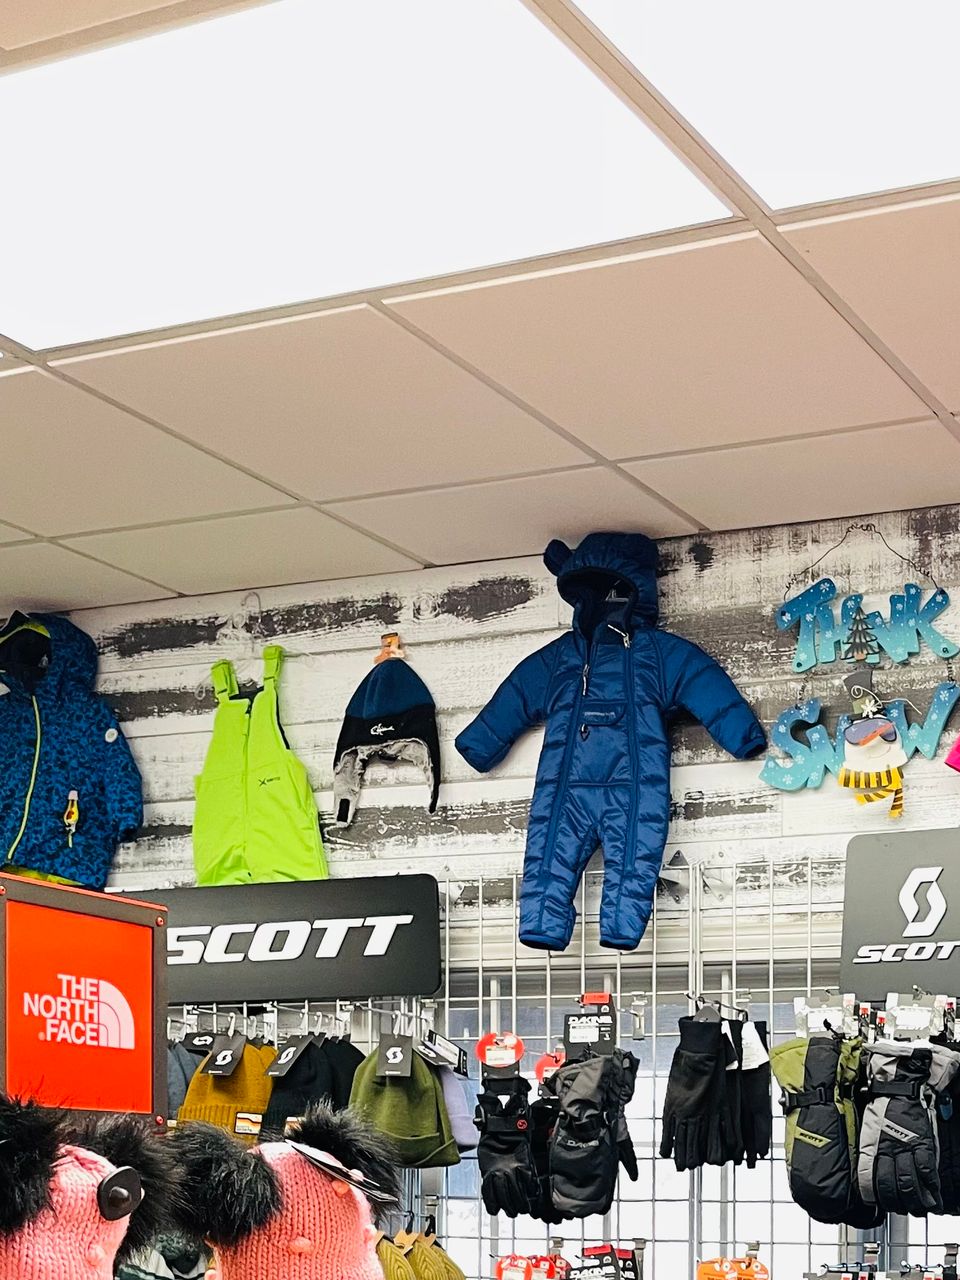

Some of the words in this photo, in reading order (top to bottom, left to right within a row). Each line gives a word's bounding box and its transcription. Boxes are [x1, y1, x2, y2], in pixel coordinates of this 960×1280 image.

[166, 914, 415, 965] SCOTT
[57, 973, 98, 1000] THE
[23, 992, 98, 1023] NORTH
[46, 1018, 98, 1046] FACE
